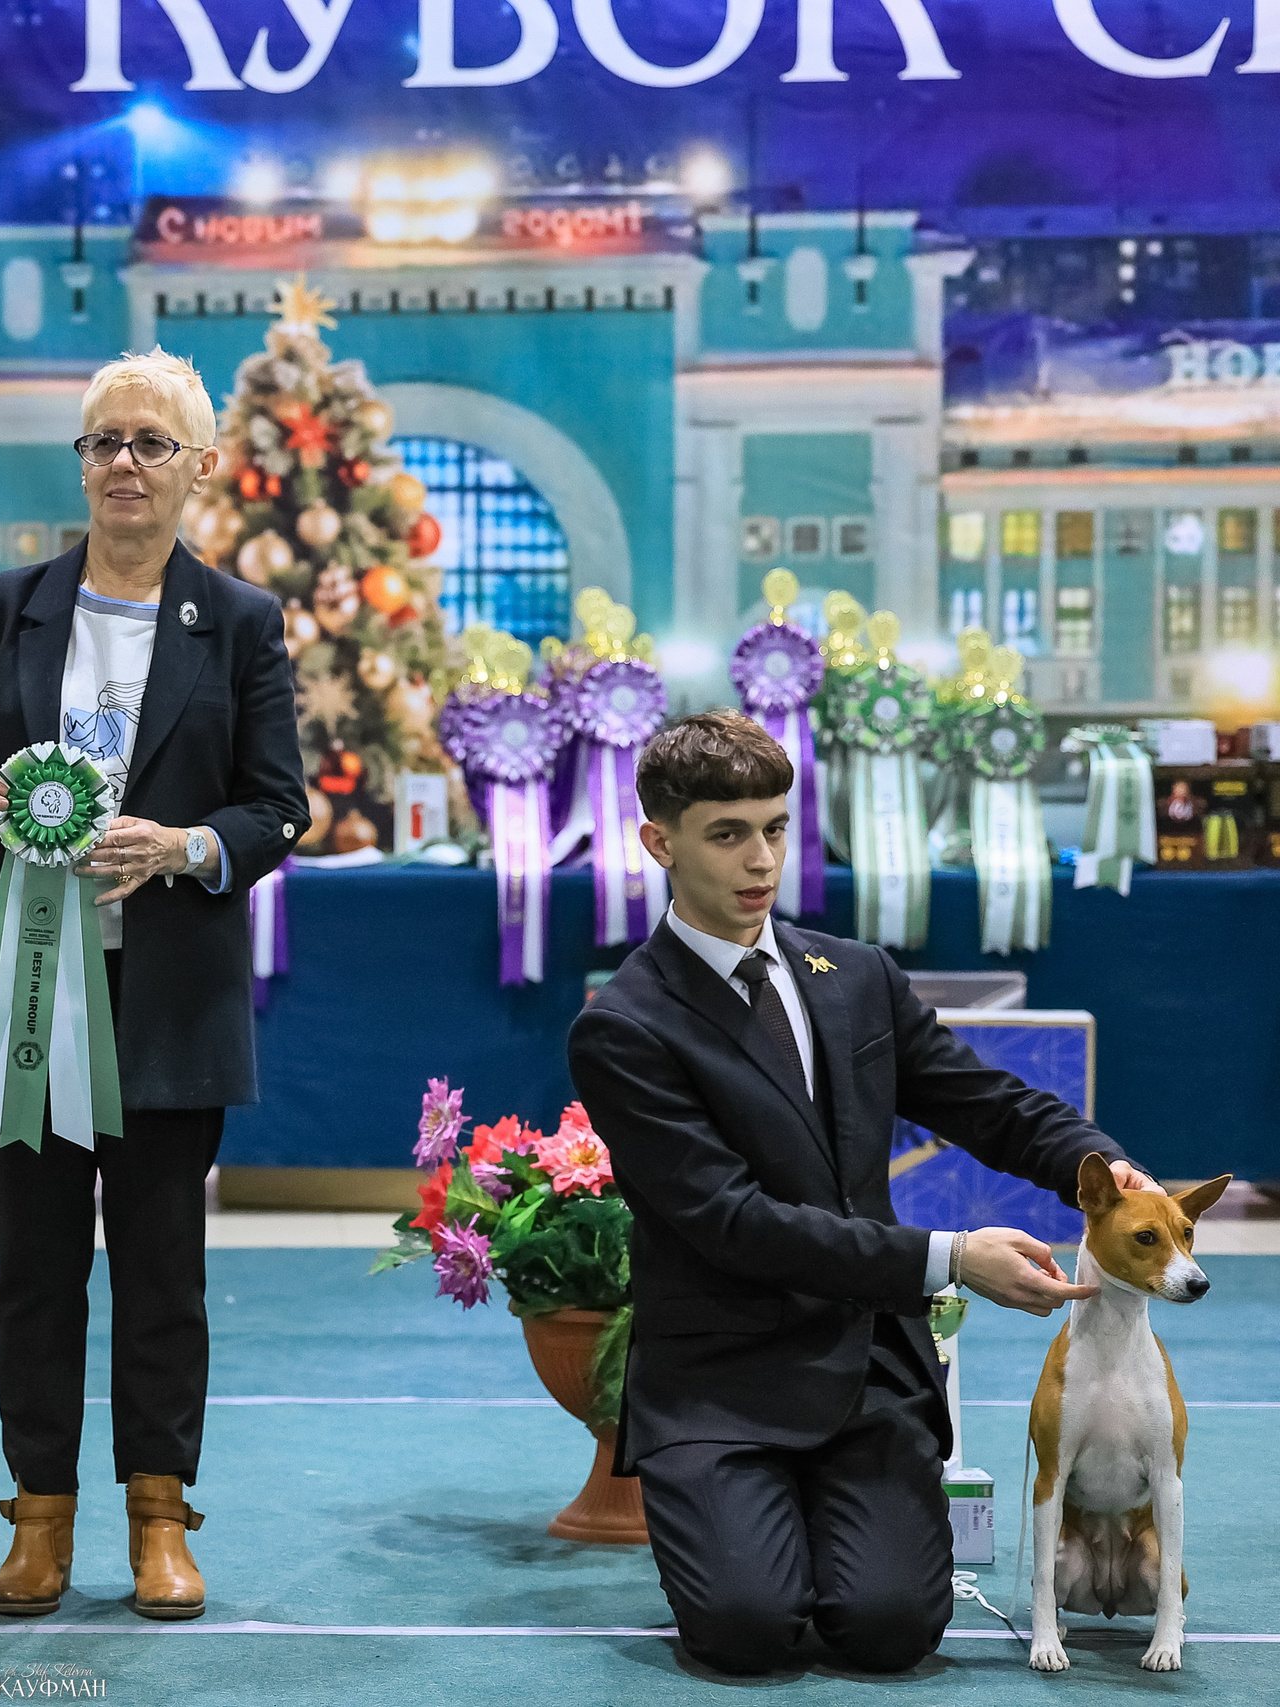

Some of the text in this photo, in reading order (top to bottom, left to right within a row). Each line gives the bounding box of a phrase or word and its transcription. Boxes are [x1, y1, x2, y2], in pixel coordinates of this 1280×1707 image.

[31, 951, 43, 979] BEST
[30, 981, 40, 993] IN
[26, 997, 39, 1035] GROUP
[23, 1048, 34, 1063] 1
